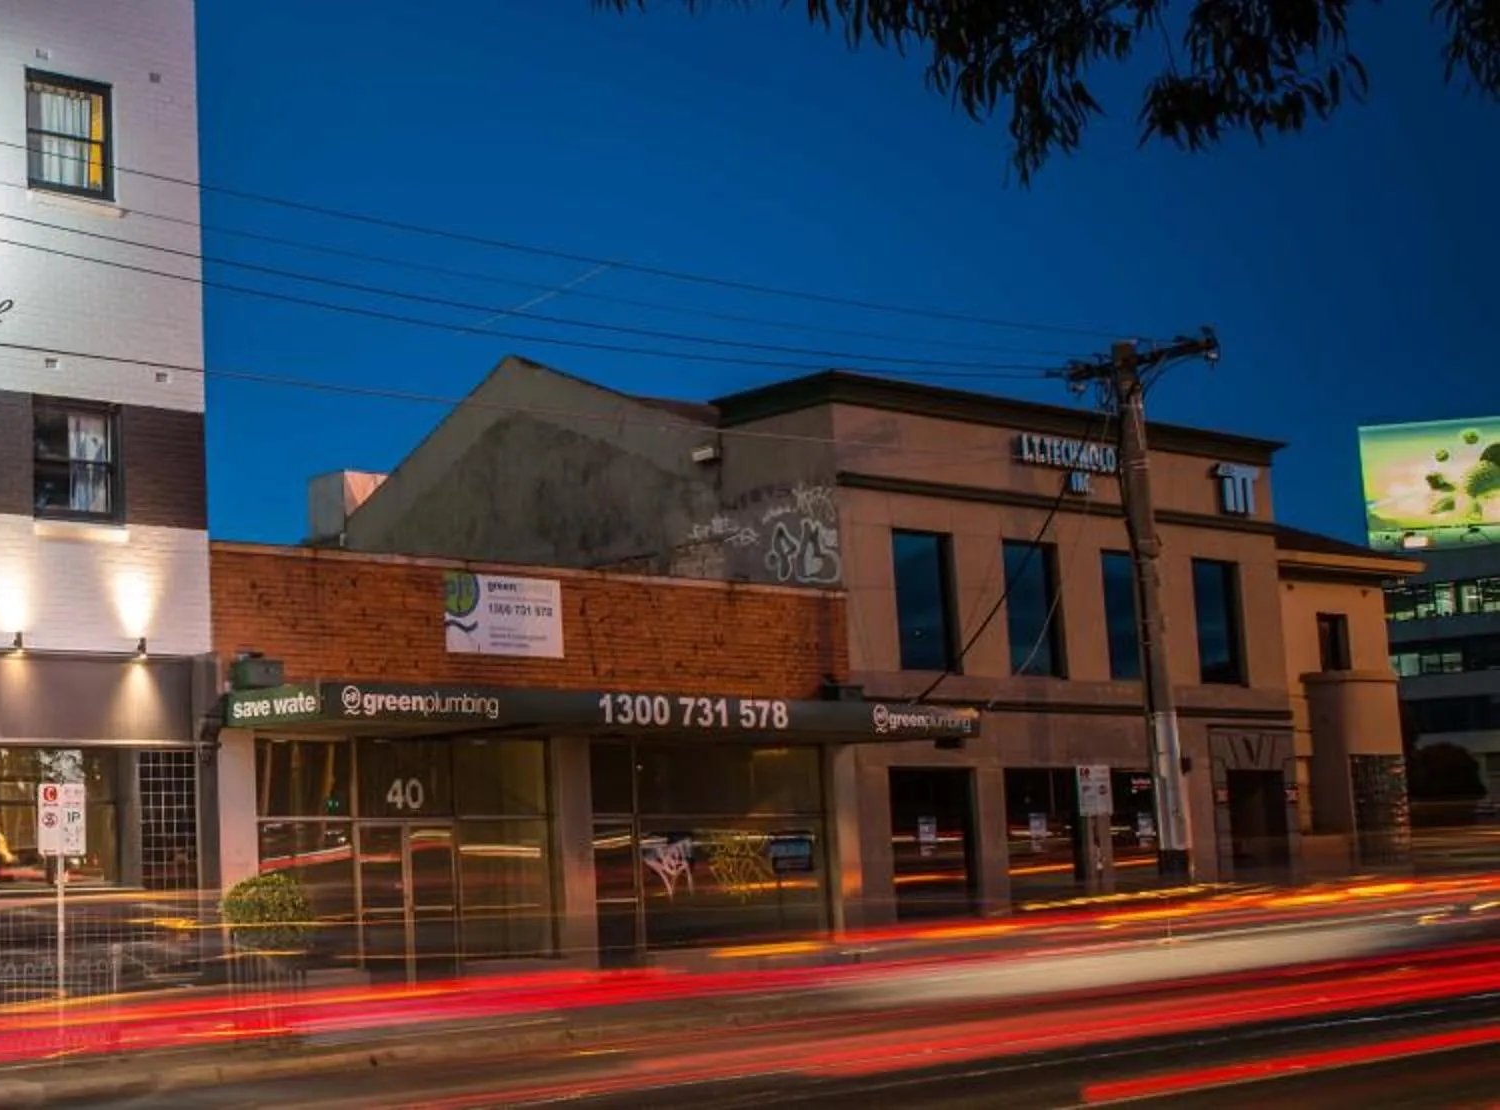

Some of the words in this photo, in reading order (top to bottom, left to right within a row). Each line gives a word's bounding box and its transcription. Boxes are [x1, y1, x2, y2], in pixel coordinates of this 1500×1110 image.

[233, 700, 270, 718] save
[272, 691, 317, 715] wate
[364, 691, 500, 719] greenplumbing
[599, 694, 670, 725] 1300
[678, 697, 730, 728] 731
[739, 700, 789, 730] 578
[387, 778, 424, 809] 40
